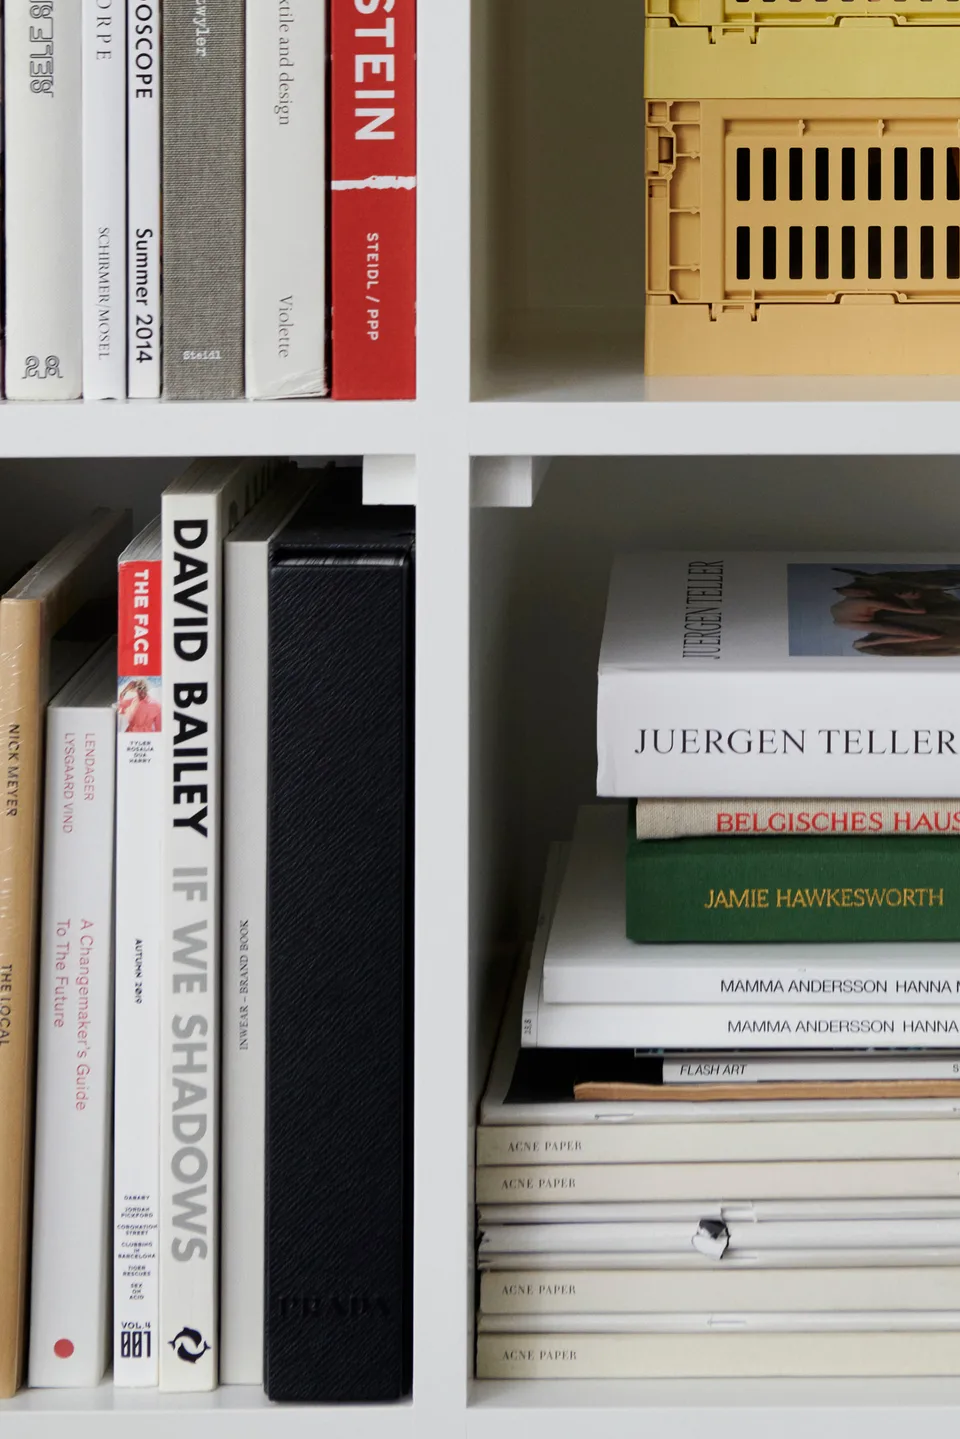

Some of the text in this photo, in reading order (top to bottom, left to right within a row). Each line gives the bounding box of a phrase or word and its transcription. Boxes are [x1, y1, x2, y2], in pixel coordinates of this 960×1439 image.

[135, 229, 153, 306] Summer
[367, 233, 379, 340] STEIDL PPP
[135, 314, 153, 362] 2014
[133, 569, 149, 666] THE FACE
[635, 729, 959, 755] JUERGEN TELLER
[6, 724, 20, 817] NICK MEYER
[716, 812, 883, 833] BELGISCHES
[171, 519, 208, 1262] DAVID BAILEY IF WE SHADOWS
[704, 888, 944, 909] JAMIE HAWKESWORTH
[721, 980, 784, 993] MAMMA
[788, 980, 887, 993] ANDERSSON
[896, 980, 952, 993] HANNA
[680, 1065, 747, 1076] FLASH ART
